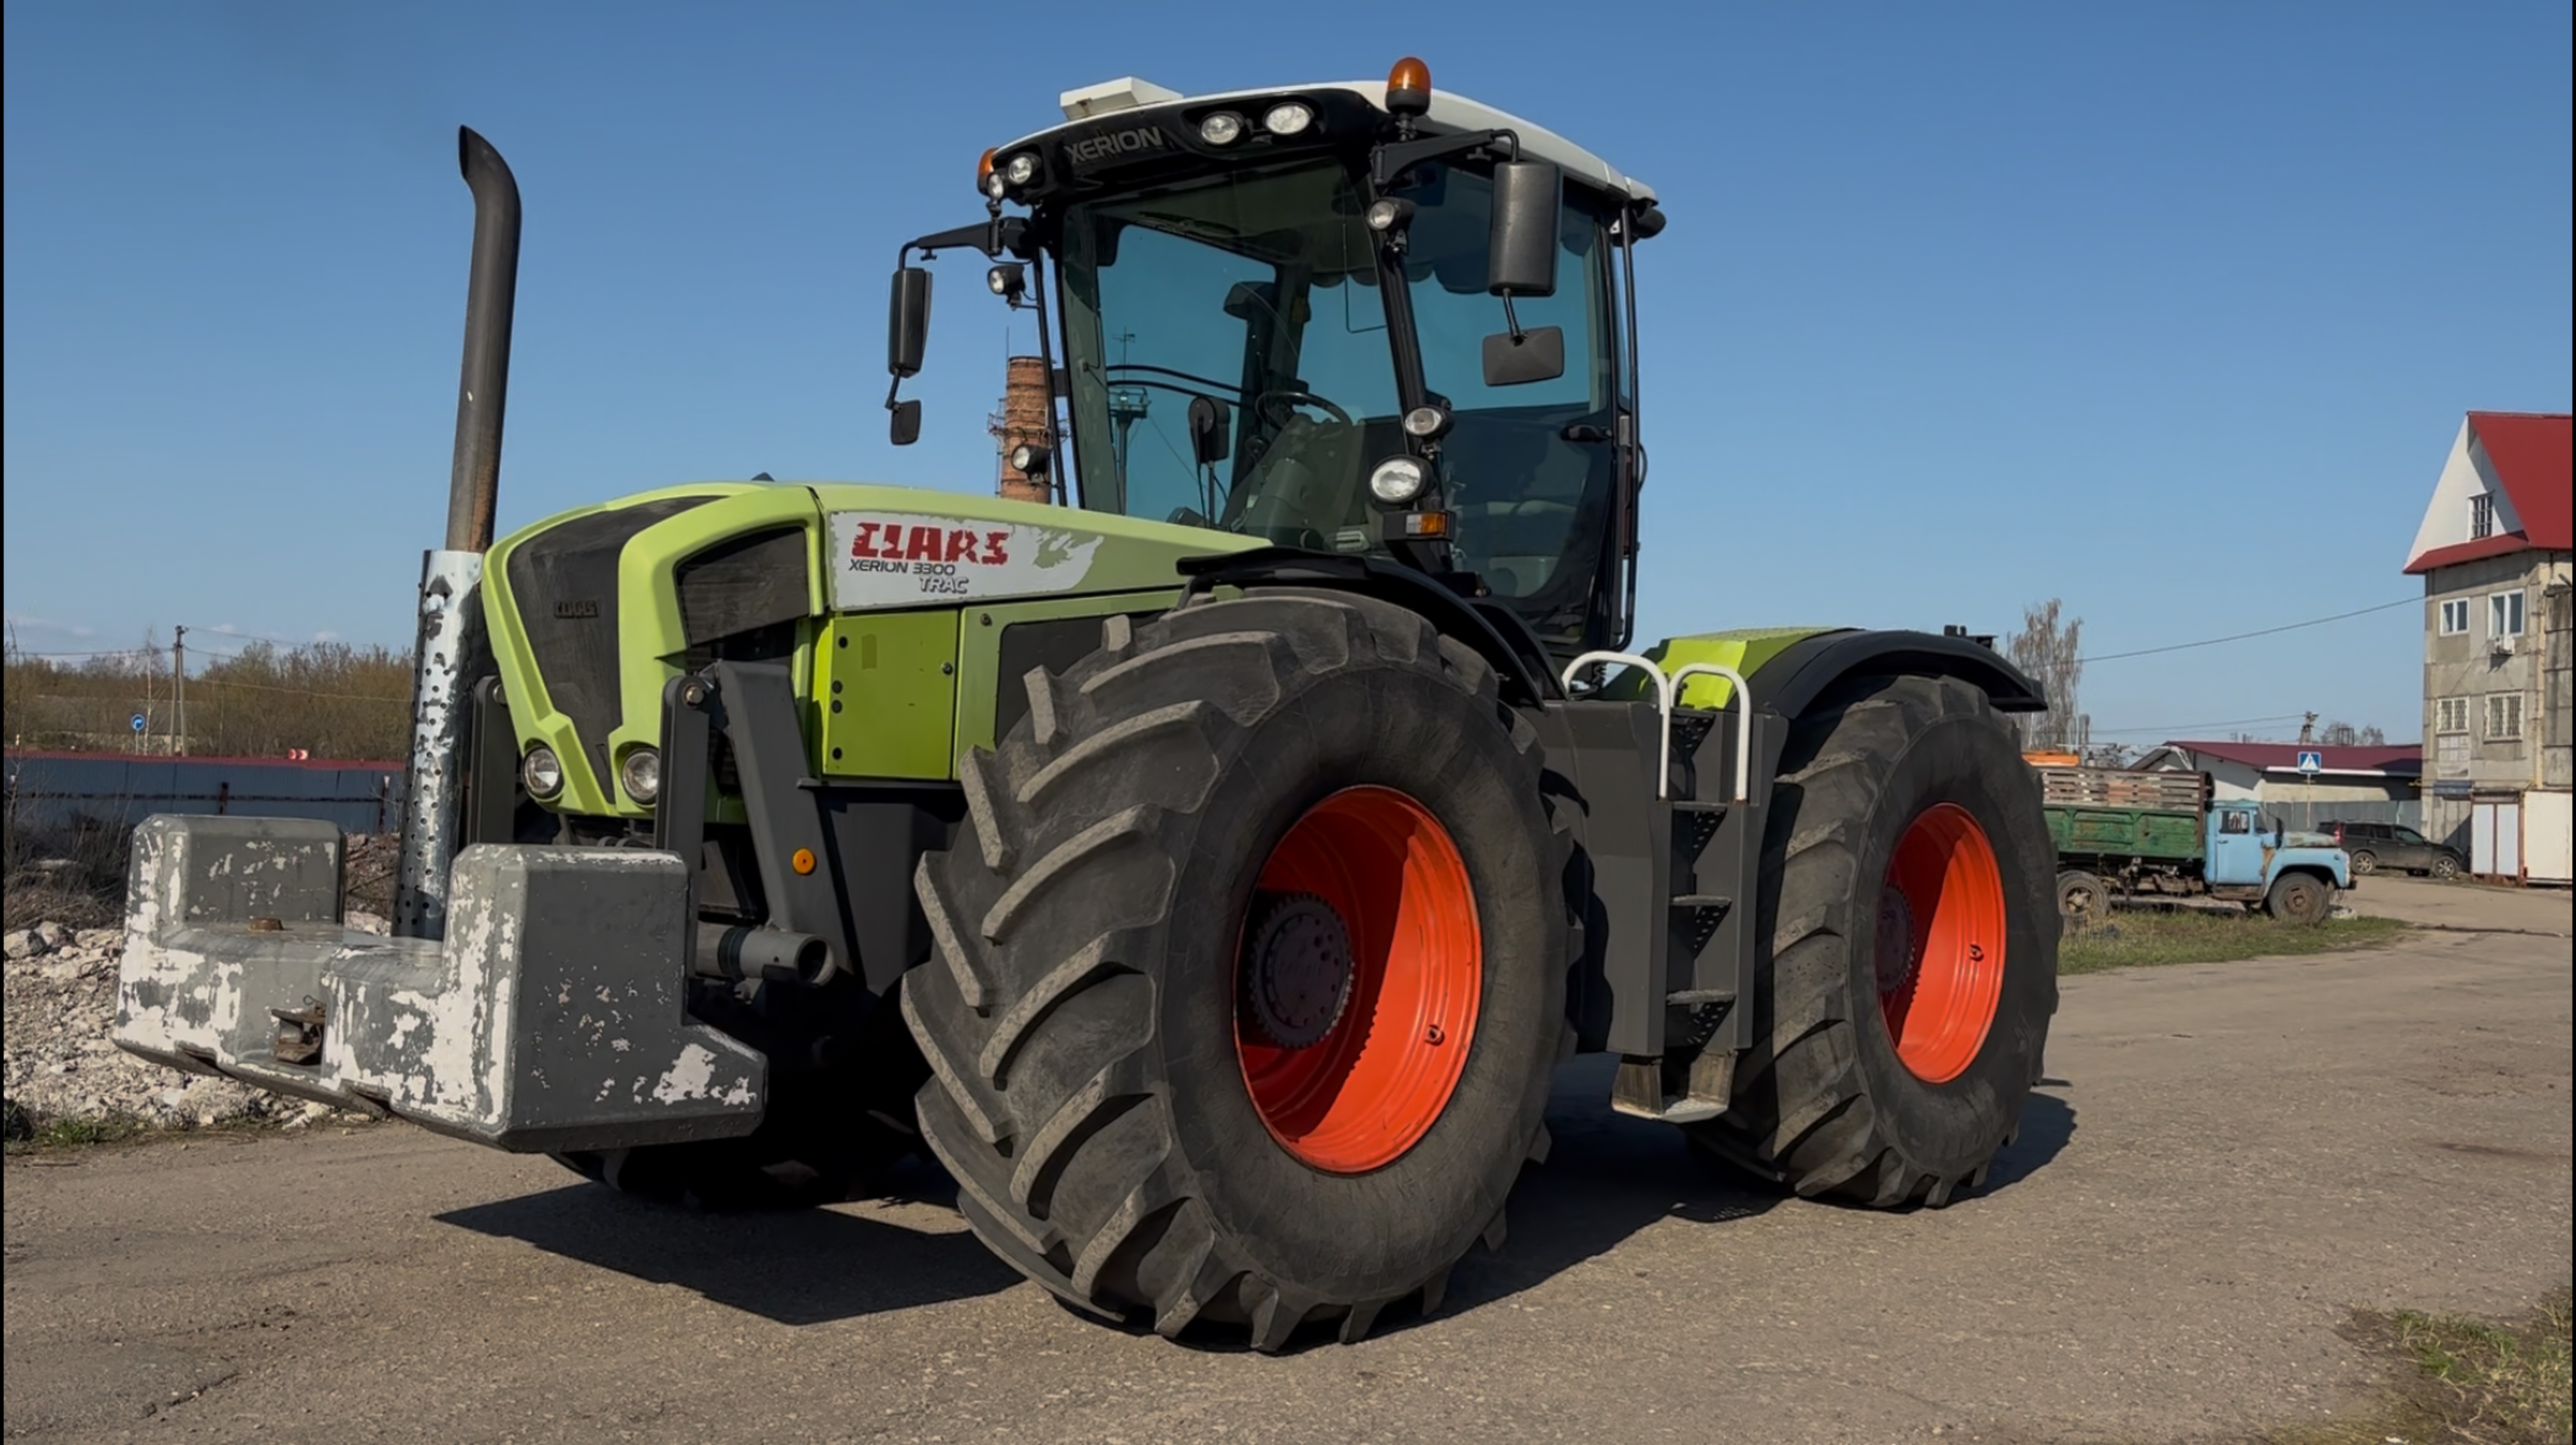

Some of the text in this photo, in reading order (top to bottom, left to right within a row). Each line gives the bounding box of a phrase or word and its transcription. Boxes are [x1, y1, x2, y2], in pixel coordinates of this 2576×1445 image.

[1063, 126, 1163, 163] XERION
[849, 558, 956, 576] XERION 3300
[919, 576, 969, 594] TRAC
